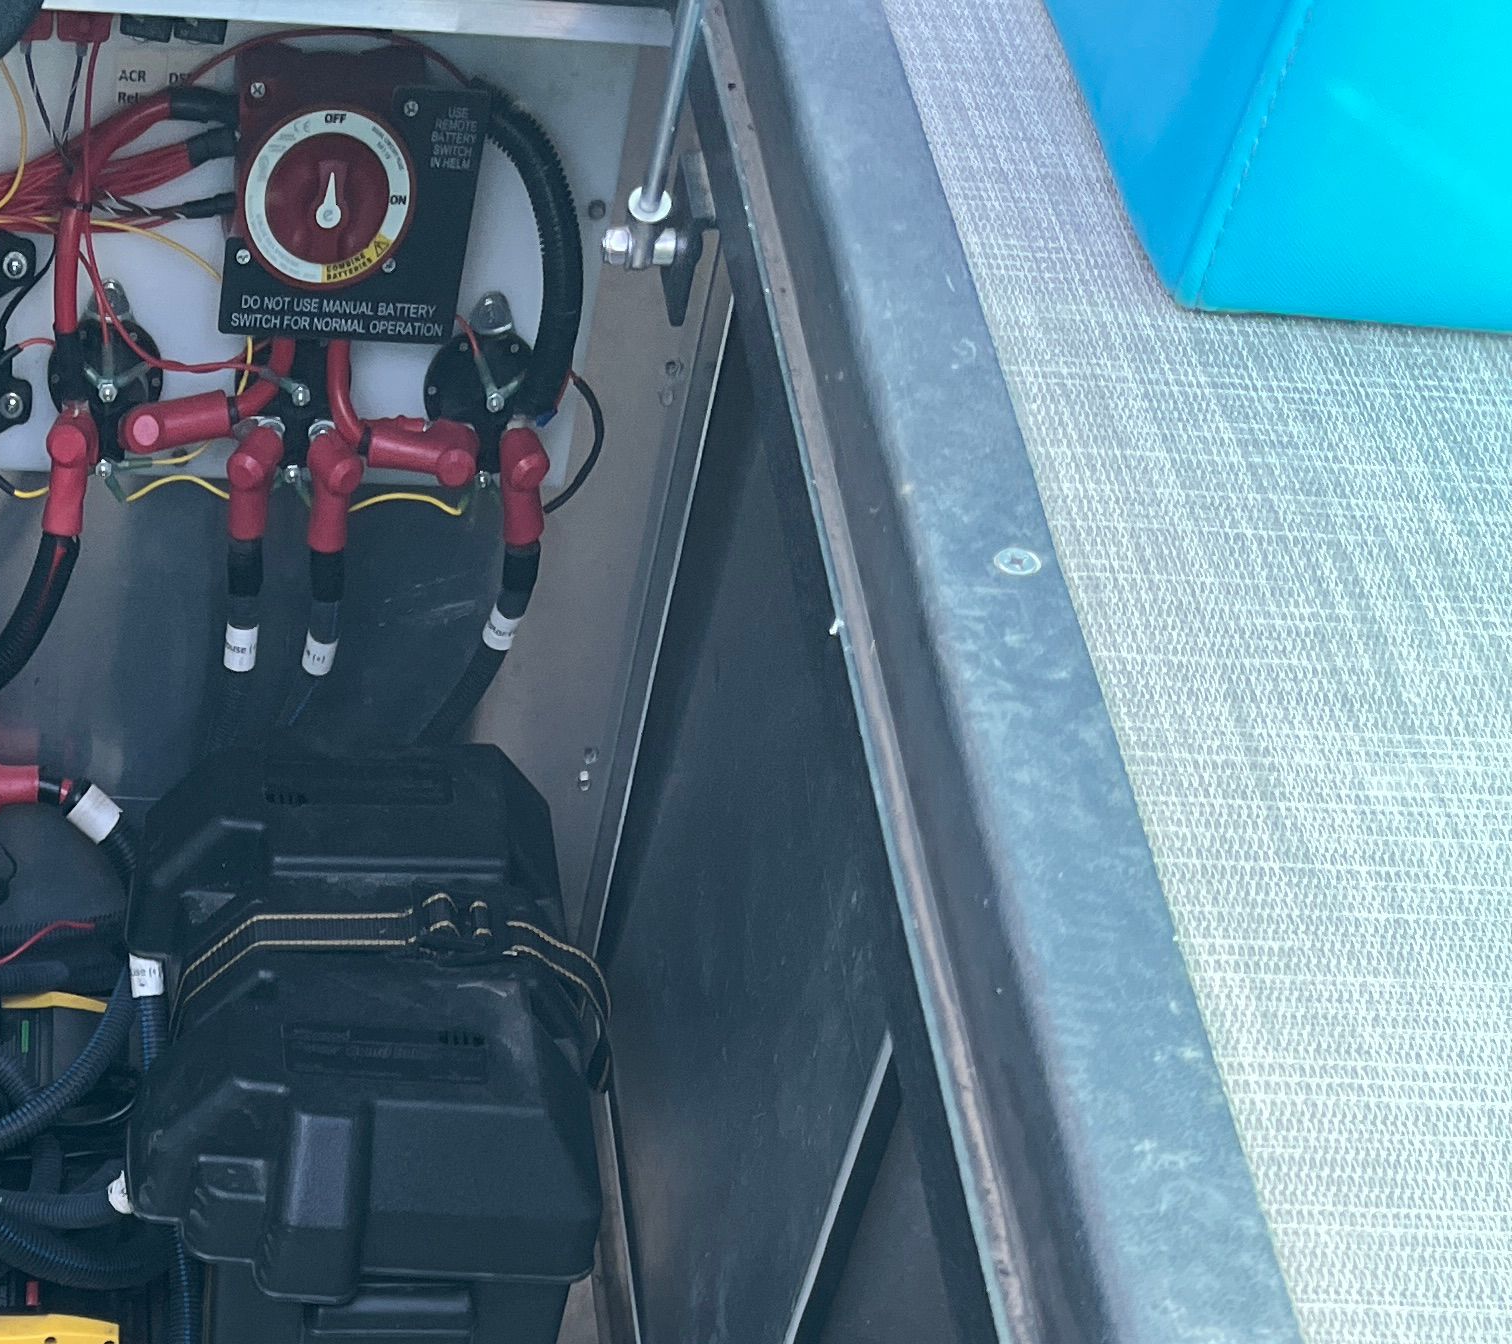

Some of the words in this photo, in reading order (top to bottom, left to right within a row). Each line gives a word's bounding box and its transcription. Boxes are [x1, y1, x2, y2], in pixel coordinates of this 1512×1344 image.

[118, 69, 147, 83] ACR
[324, 113, 347, 124] OFF
[448, 106, 469, 119] USE
[435, 119, 478, 133] REMOTE
[431, 131, 478, 144] BATTERY
[433, 144, 473, 157] SWITCH
[430, 156, 441, 169] IN
[442, 157, 471, 169] HELM
[390, 194, 407, 205] ON
[326, 252, 366, 272] COMBINE
[326, 257, 373, 281] BATTERIES
[241, 295, 261, 309] DO
[263, 296, 291, 311] NOT
[293, 298, 319, 312] USE
[322, 300, 374, 316] MANUAL
[377, 302, 437, 318] BATTERY
[231, 312, 280, 329] SWITCH
[283, 315, 310, 330] FOR
[313, 317, 366, 333] NORMAL
[369, 320, 443, 337] OPERATION
